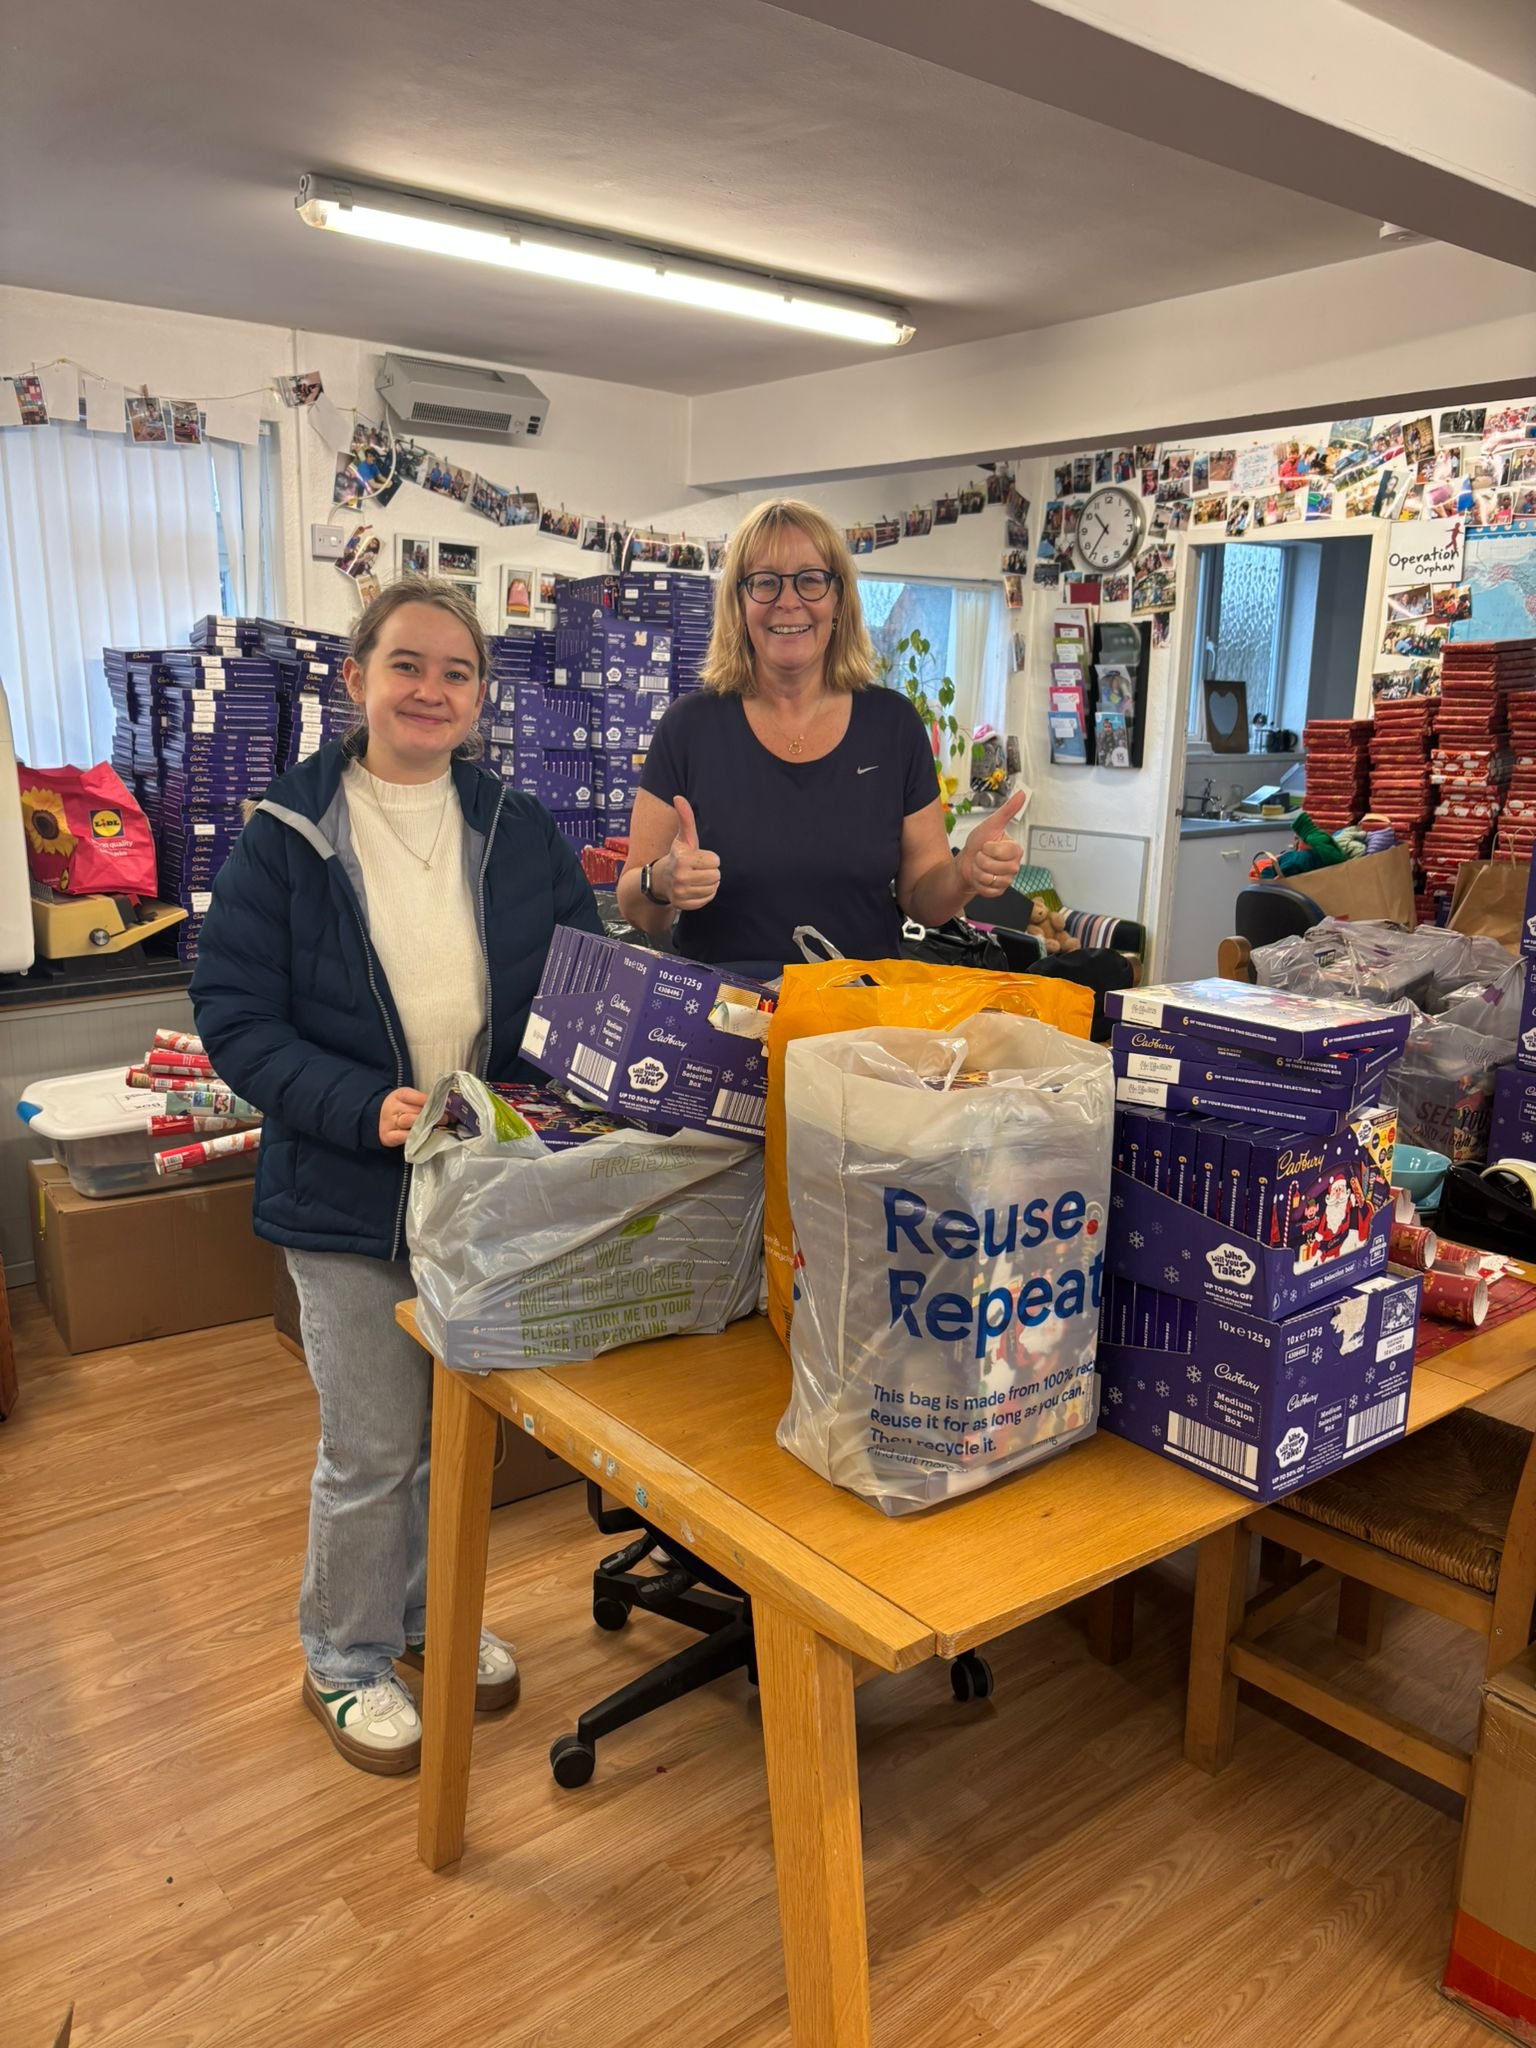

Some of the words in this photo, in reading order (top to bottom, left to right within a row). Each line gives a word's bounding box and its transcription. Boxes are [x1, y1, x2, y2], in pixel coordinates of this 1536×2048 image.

[1389, 547, 1460, 570] Operation
[1415, 563, 1456, 577] Orphan
[1116, 752, 1125, 761] 15
[1183, 1016, 1189, 1026] 6
[648, 1028, 687, 1050] Cadbury
[1132, 1033, 1175, 1054] Cadbury
[1322, 1037, 1328, 1047] 6
[645, 1063, 659, 1071] Who
[686, 1064, 712, 1074] Medium
[1276, 1057, 1283, 1067] 6
[1303, 1066, 1330, 1074] SELECTION
[682, 1071, 712, 1082] Selection
[689, 1080, 701, 1088] Box
[1205, 1072, 1213, 1080] 6
[1236, 1077, 1265, 1086] FAVOURITES
[1284, 1084, 1310, 1092] SELECTION
[1192, 1096, 1199, 1105] 6
[1221, 1102, 1250, 1111] FAVOURITES
[1269, 1109, 1295, 1118] SELECTION
[1416, 1102, 1455, 1126] SEE
[1460, 1106, 1490, 1130] YOU
[1204, 1162, 1213, 1170] 6
[1276, 1150, 1325, 1180] Cadbury
[1259, 1176, 1268, 1184] 6
[883, 1186, 1098, 1259] Reuse.
[593, 1239, 634, 1269] WE
[1224, 1250, 1242, 1260] Who
[1224, 1258, 1239, 1267] you
[1214, 1262, 1251, 1278] Take?
[519, 1280, 572, 1317] MET
[582, 1260, 695, 1305] BEFORE?
[1224, 1288, 1239, 1297] 50%
[521, 1325, 568, 1341] PLEASE
[573, 1313, 620, 1332] RETURN
[624, 1308, 640, 1321] ME
[646, 1305, 657, 1318] TO
[663, 1300, 691, 1315] YOUR
[575, 1334, 599, 1348] FOR
[602, 1320, 668, 1344] RECYCLING
[873, 1384, 904, 1403] This
[910, 1392, 941, 1411] bag
[945, 1396, 958, 1410] is
[964, 1391, 1005, 1410] made
[1008, 1381, 1039, 1401] from
[1043, 1366, 1073, 1390] 100%
[1076, 1360, 1095, 1377] rec
[1214, 1363, 1260, 1394] Cadbury
[870, 1408, 921, 1429] Reuse
[927, 1414, 939, 1429] it
[944, 1417, 969, 1433] for
[972, 1418, 988, 1431] as
[991, 1409, 1021, 1427] long
[1024, 1405, 1037, 1419] as
[1038, 1396, 1058, 1416] you
[1062, 1385, 1085, 1402] can.
[1217, 1391, 1252, 1412] Medium
[1287, 1392, 1319, 1412] Cadbury
[1213, 1400, 1255, 1423] Selection
[1224, 1416, 1242, 1428] Box
[916, 1440, 979, 1456] recycle
[983, 1437, 997, 1453] it.
